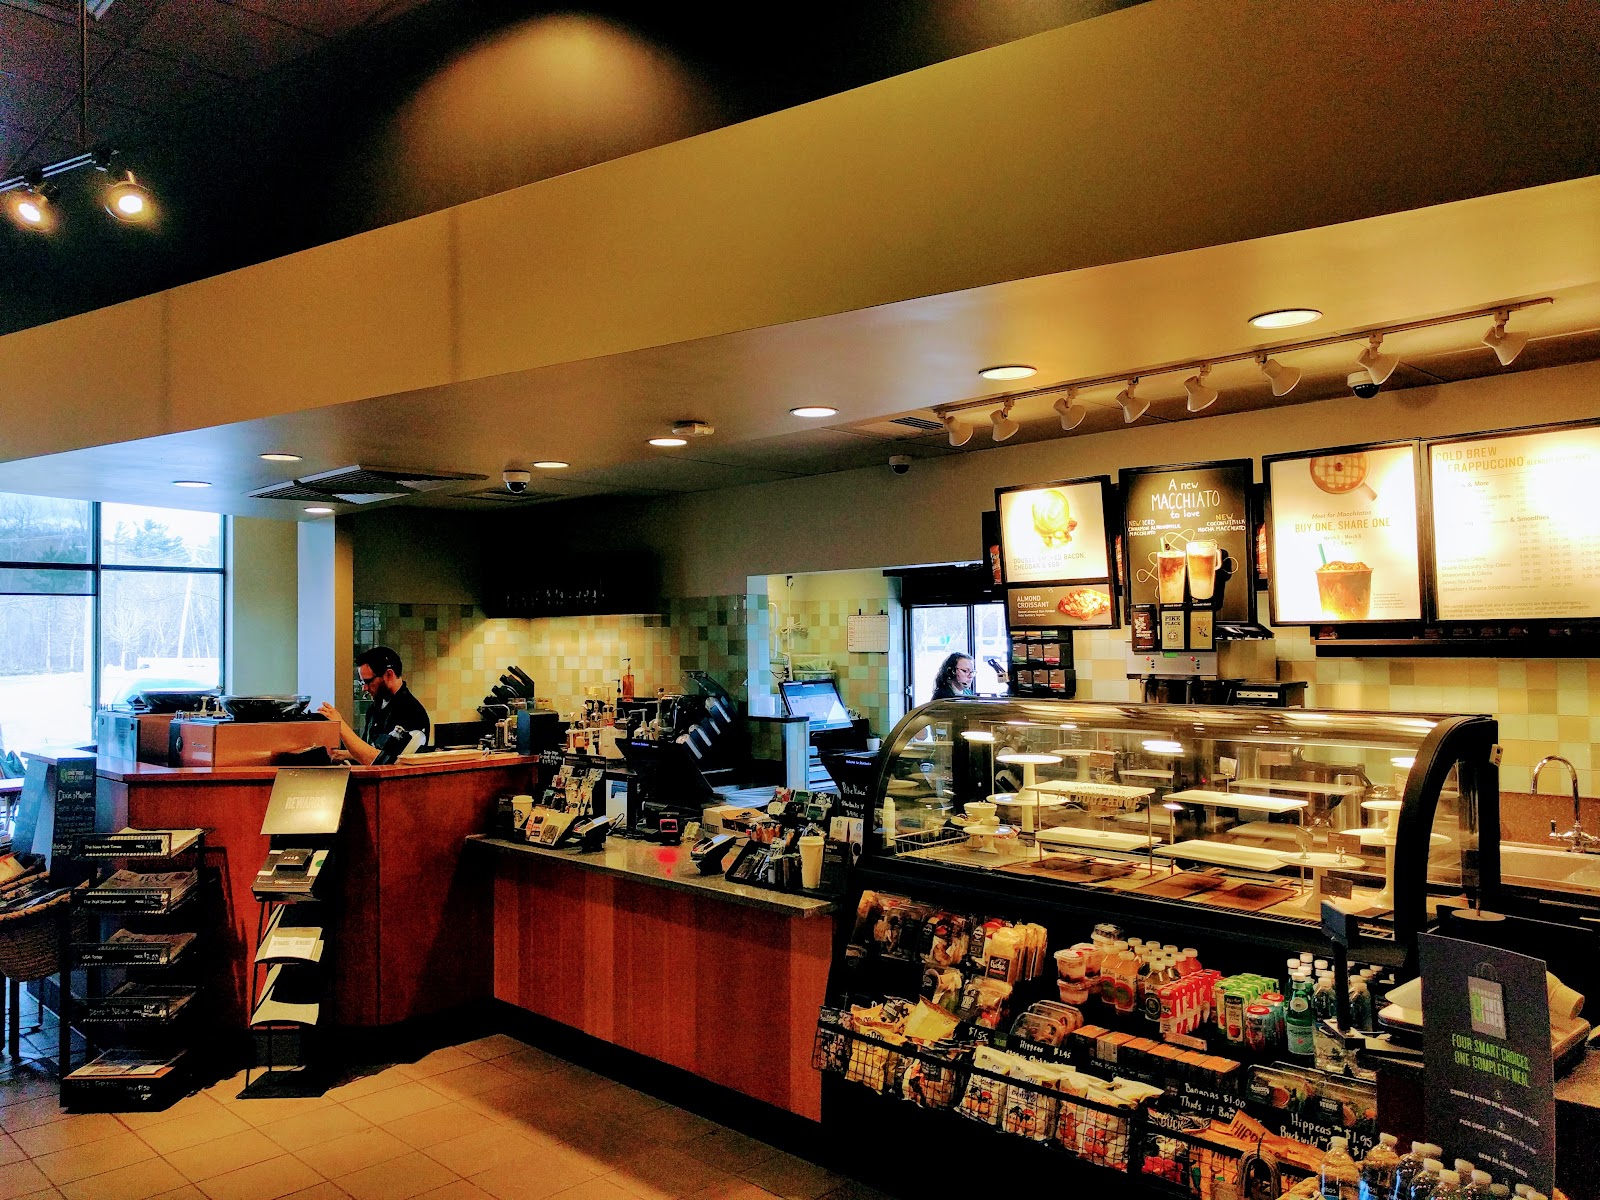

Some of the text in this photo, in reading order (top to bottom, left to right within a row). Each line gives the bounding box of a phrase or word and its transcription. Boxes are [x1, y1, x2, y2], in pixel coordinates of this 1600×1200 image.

[1466, 446, 1497, 459] BREW
[1447, 456, 1525, 473] FRAPPUCCINO
[1168, 478, 1199, 491] A new
[1151, 489, 1221, 512] MACCHIATO
[1170, 508, 1201, 519] to love
[1215, 512, 1234, 521] NEW
[1336, 509, 1372, 518] Macchiatos
[1516, 514, 1550, 522] Smoothies
[1128, 519, 1141, 527] NEW
[1215, 524, 1246, 532] MACCHIATO
[1295, 517, 1391, 533] BUY ONE, SHARE ONE
[1013, 556, 1036, 565] DOUBLE
[1013, 563, 1041, 571] CHEDDAR
[1017, 601, 1050, 609] CROISSANT
[284, 796, 327, 810] REWARDS
[1451, 1033, 1473, 1051] FOUR
[1474, 1039, 1499, 1059] SMART
[1454, 1050, 1471, 1067] ONE
[1472, 1055, 1511, 1081] COMPLETE
[1184, 1082, 1247, 1109] Bananas $1.00
[1230, 1120, 1259, 1142] HIPP
[1290, 1112, 1373, 1148] Hippeas $1.95
